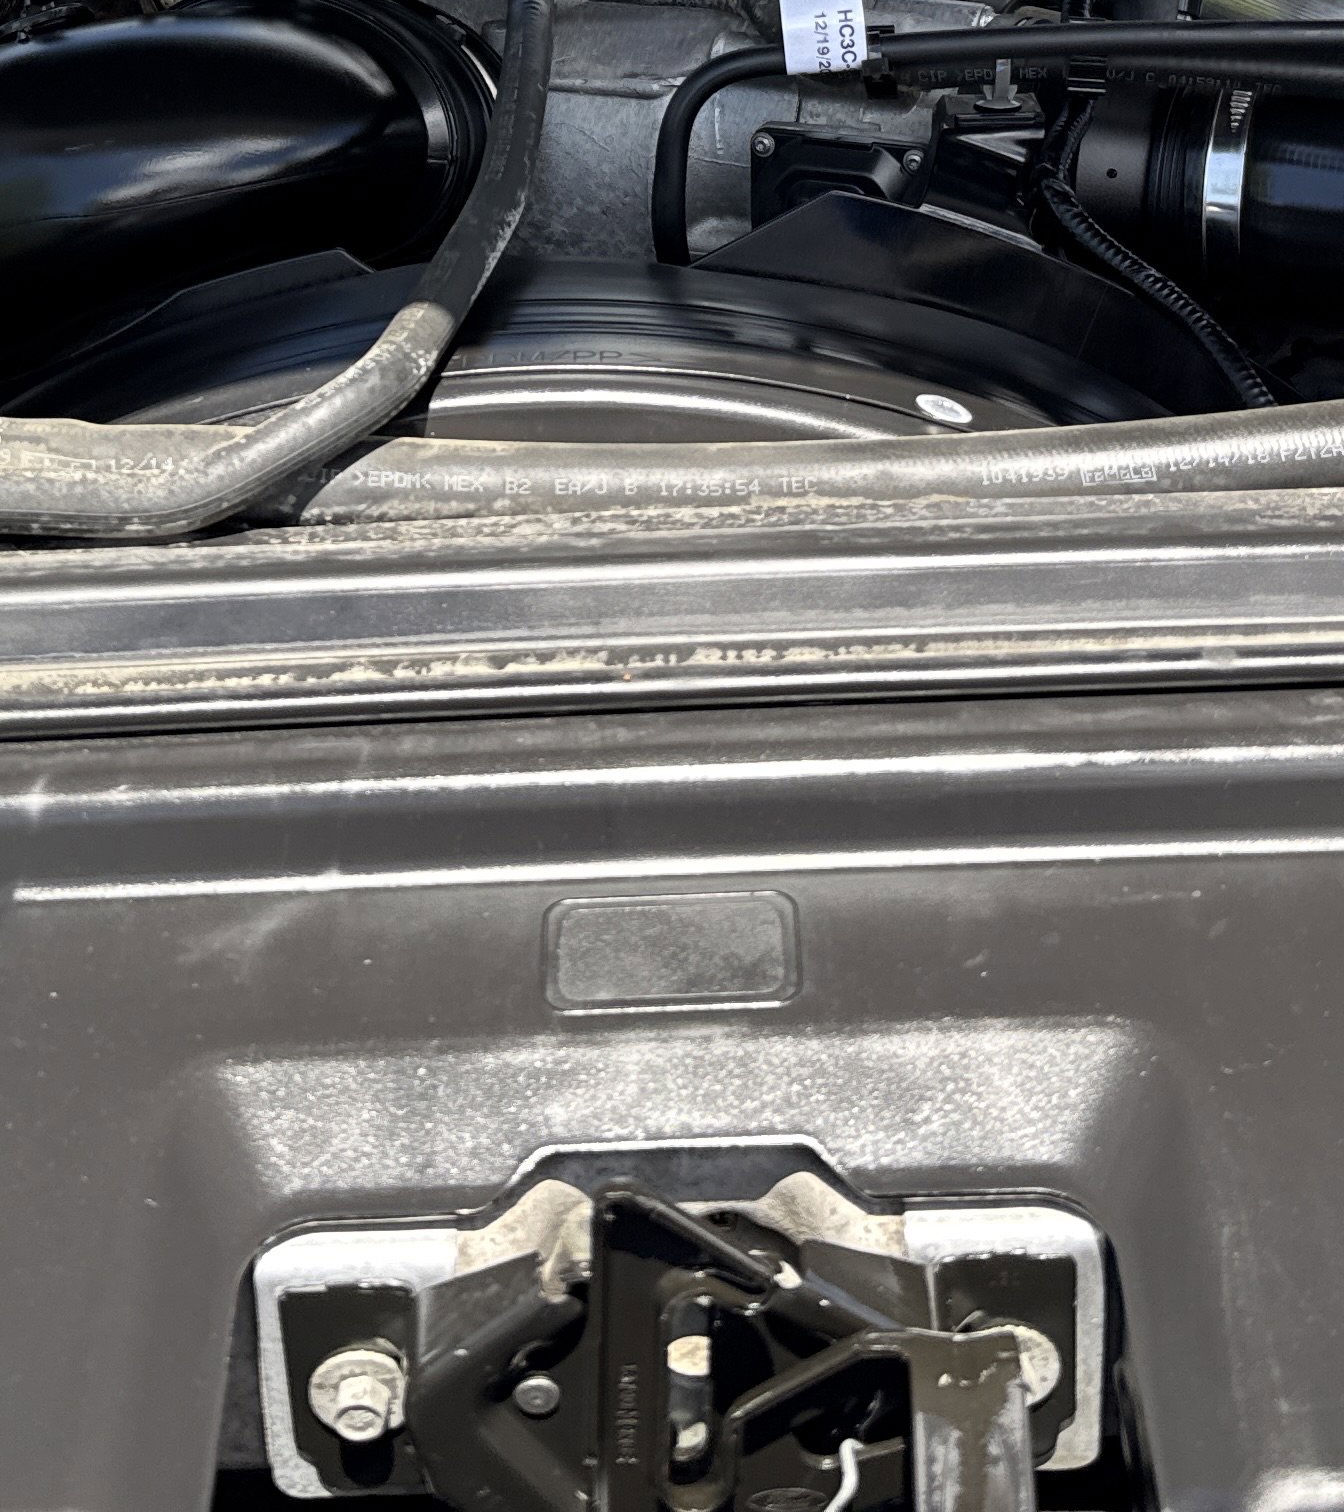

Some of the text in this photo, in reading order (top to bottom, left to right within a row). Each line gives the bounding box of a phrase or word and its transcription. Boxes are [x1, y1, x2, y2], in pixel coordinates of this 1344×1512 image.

[1018, 66, 1048, 80] MEX
[444, 474, 485, 493] MEX
[504, 477, 532, 495] B2
[659, 478, 761, 497] 17:35:54
[778, 476, 818, 494] TEC
